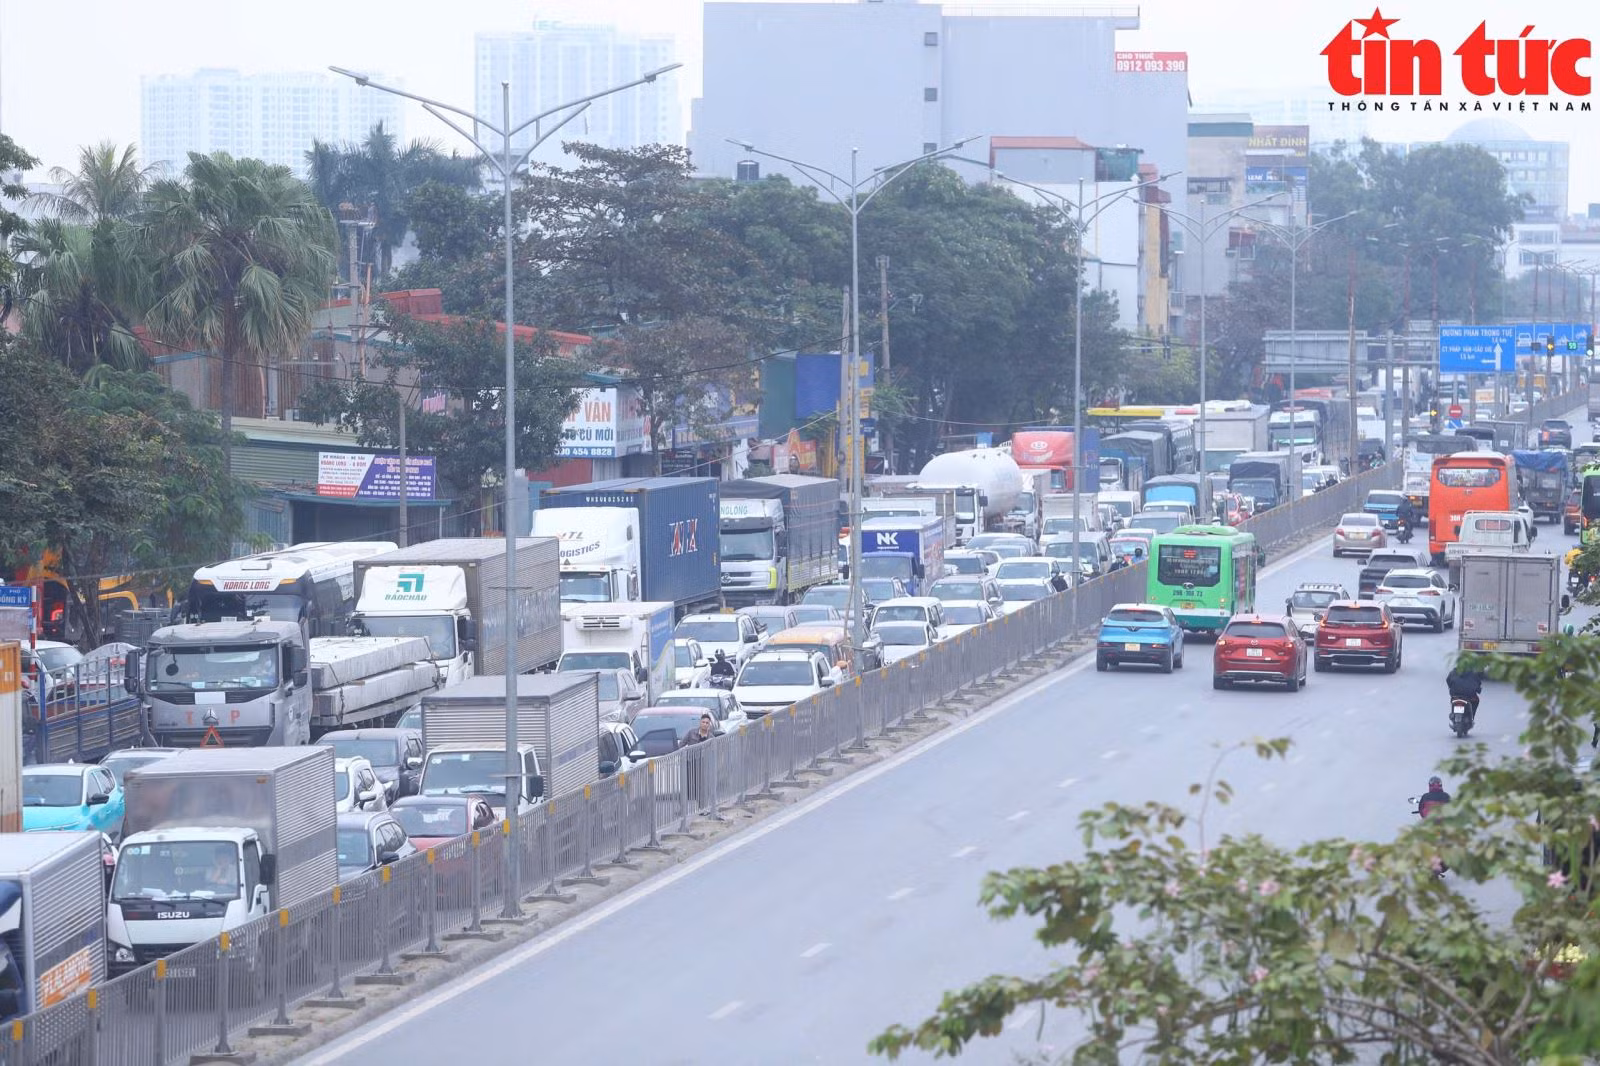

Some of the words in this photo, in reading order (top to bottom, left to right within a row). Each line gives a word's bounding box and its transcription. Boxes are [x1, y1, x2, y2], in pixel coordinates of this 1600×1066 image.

[1116, 60, 1142, 72] 0912
[1144, 60, 1164, 72] 093
[583, 397, 612, 423] VÂN
[595, 426, 614, 441] MỚI
[572, 447, 589, 456] 454
[876, 532, 899, 546] NK
[559, 540, 601, 558] OGISTICS
[250, 581, 271, 590] LONG
[230, 709, 241, 724] P
[157, 911, 190, 919] ISUZU
